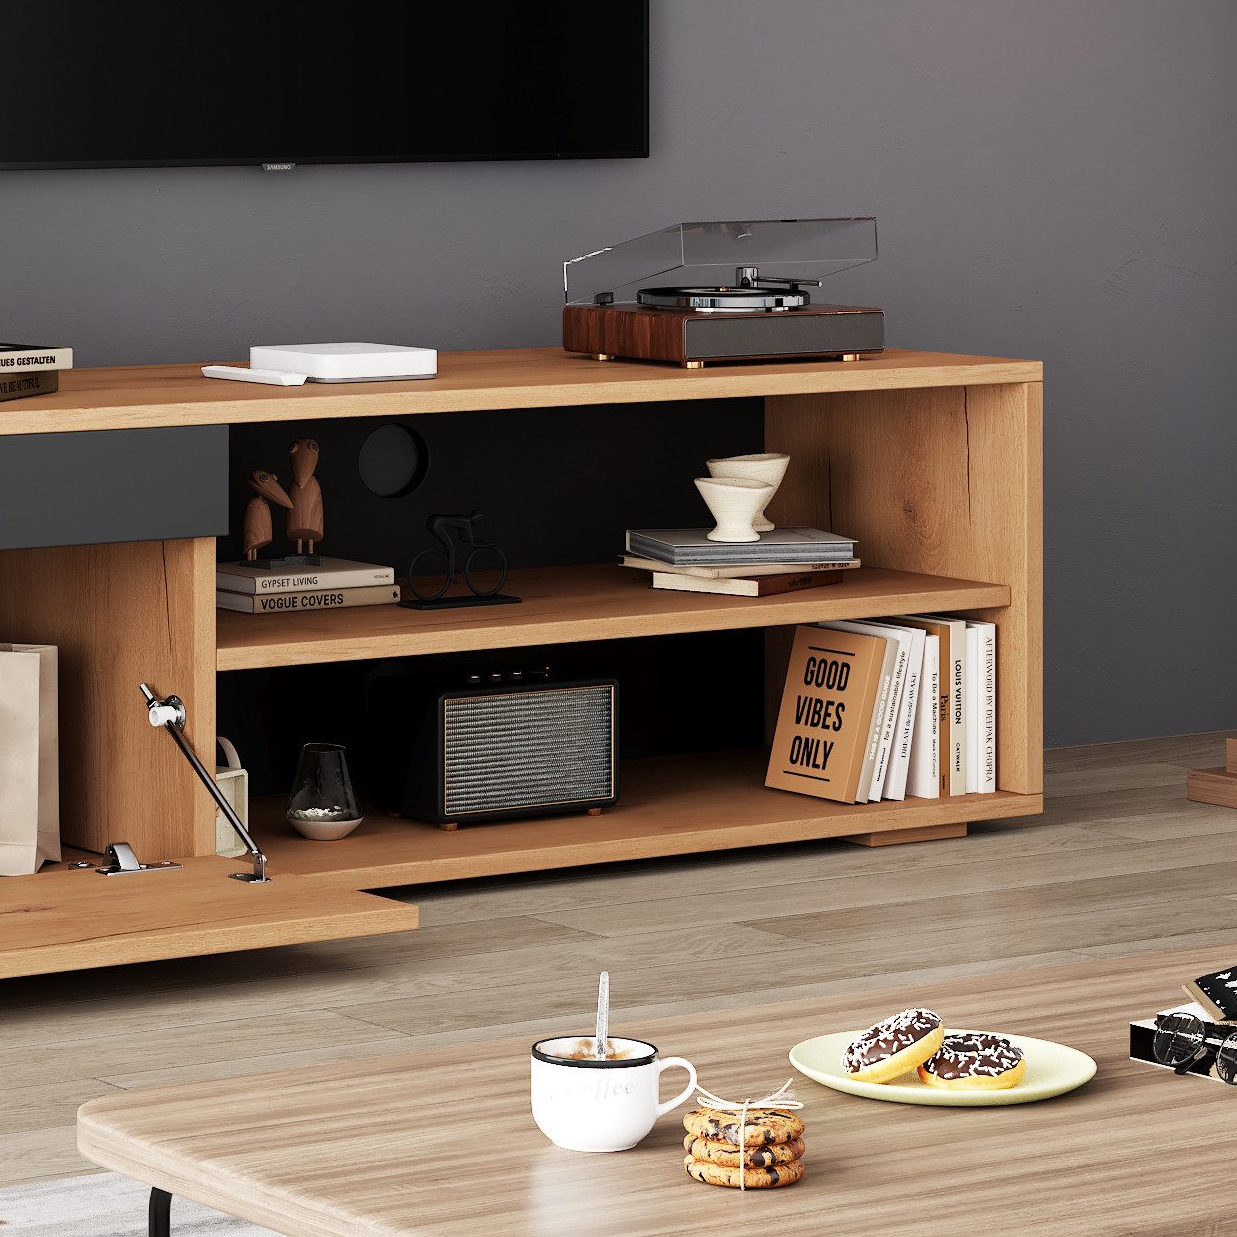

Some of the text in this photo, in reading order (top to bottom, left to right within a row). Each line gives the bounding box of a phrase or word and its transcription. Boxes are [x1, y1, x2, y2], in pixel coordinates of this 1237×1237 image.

[16, 355, 56, 367] GESTALTEN
[8, 378, 40, 393] BEAUTIFUL
[261, 576, 318, 588] GYPSET LIVING
[260, 593, 344, 611] VOGUE COVERS
[803, 656, 851, 692] GOOD
[894, 650, 906, 679] lifestyle
[932, 672, 938, 681] To
[954, 659, 962, 686] LOUIS
[795, 694, 846, 732] VIBES
[886, 680, 900, 722] sustainable
[940, 694, 949, 722] Paris
[954, 687, 962, 725] VUITTON
[985, 636, 993, 783] AFTERWORD BY DEEPAK CHOPRA
[883, 730, 891, 741] for
[789, 735, 835, 771] ONLY
